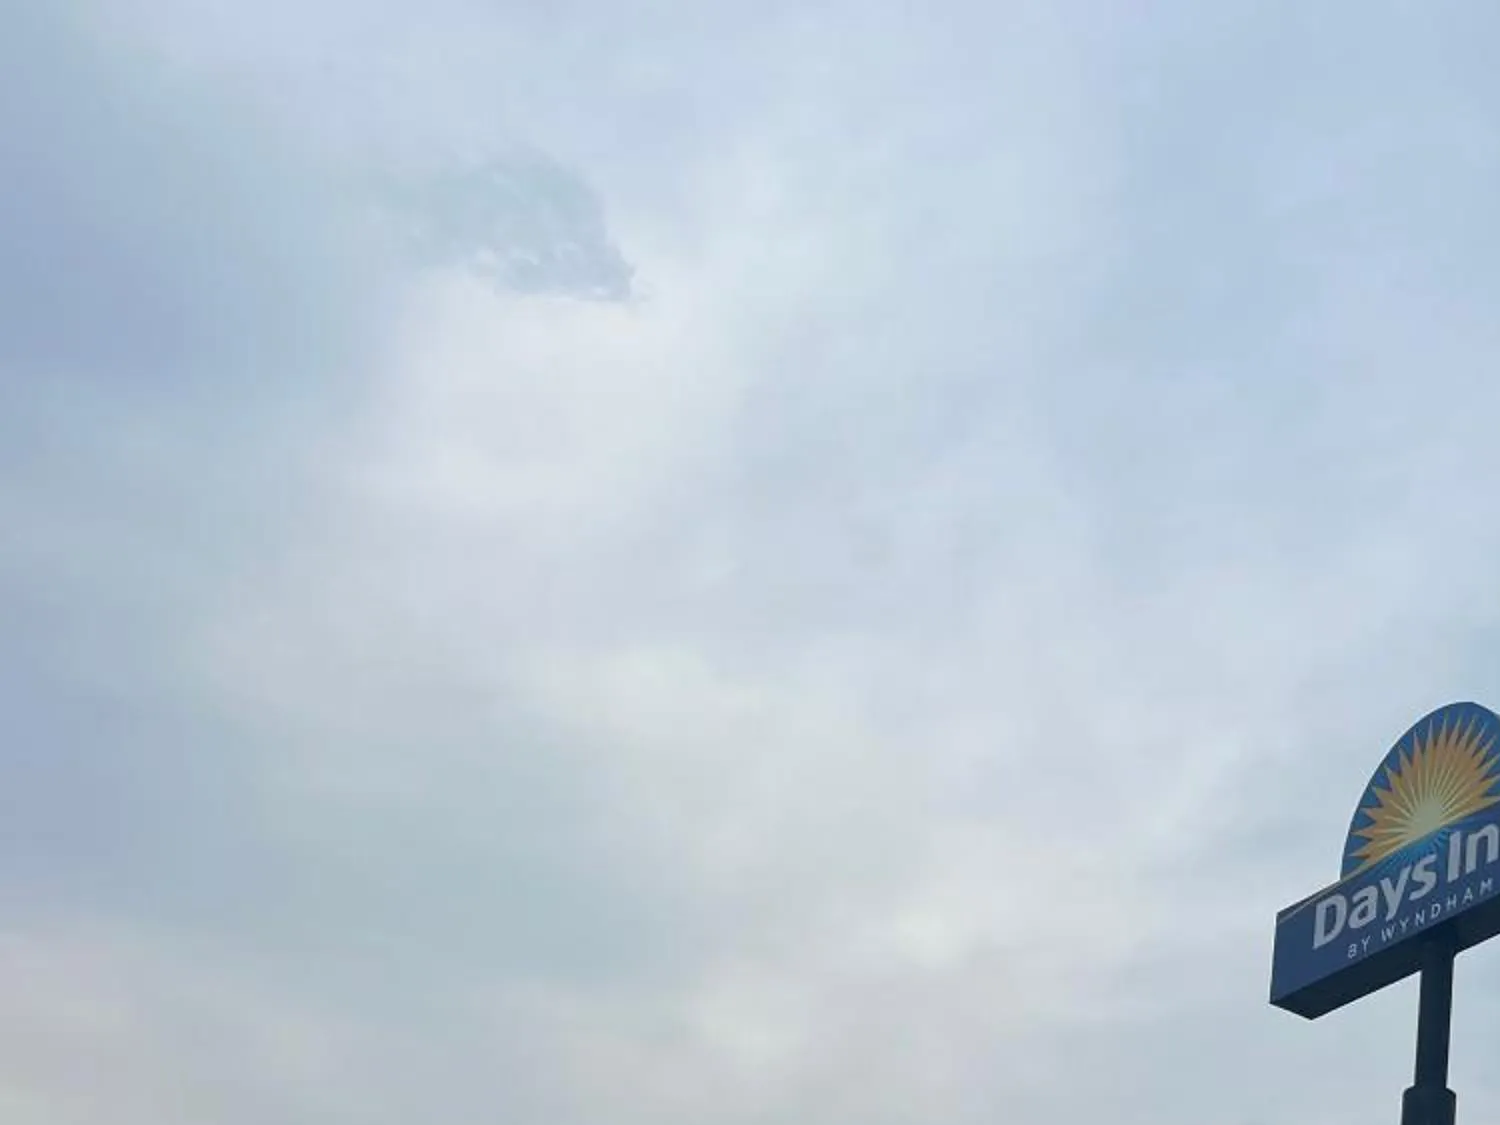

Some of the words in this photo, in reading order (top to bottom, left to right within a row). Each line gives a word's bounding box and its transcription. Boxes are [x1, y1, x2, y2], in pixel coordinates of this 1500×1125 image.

[1313, 855, 1437, 949] Days
[1347, 935, 1371, 958] BY
[1380, 878, 1494, 941] WYNDHAM
